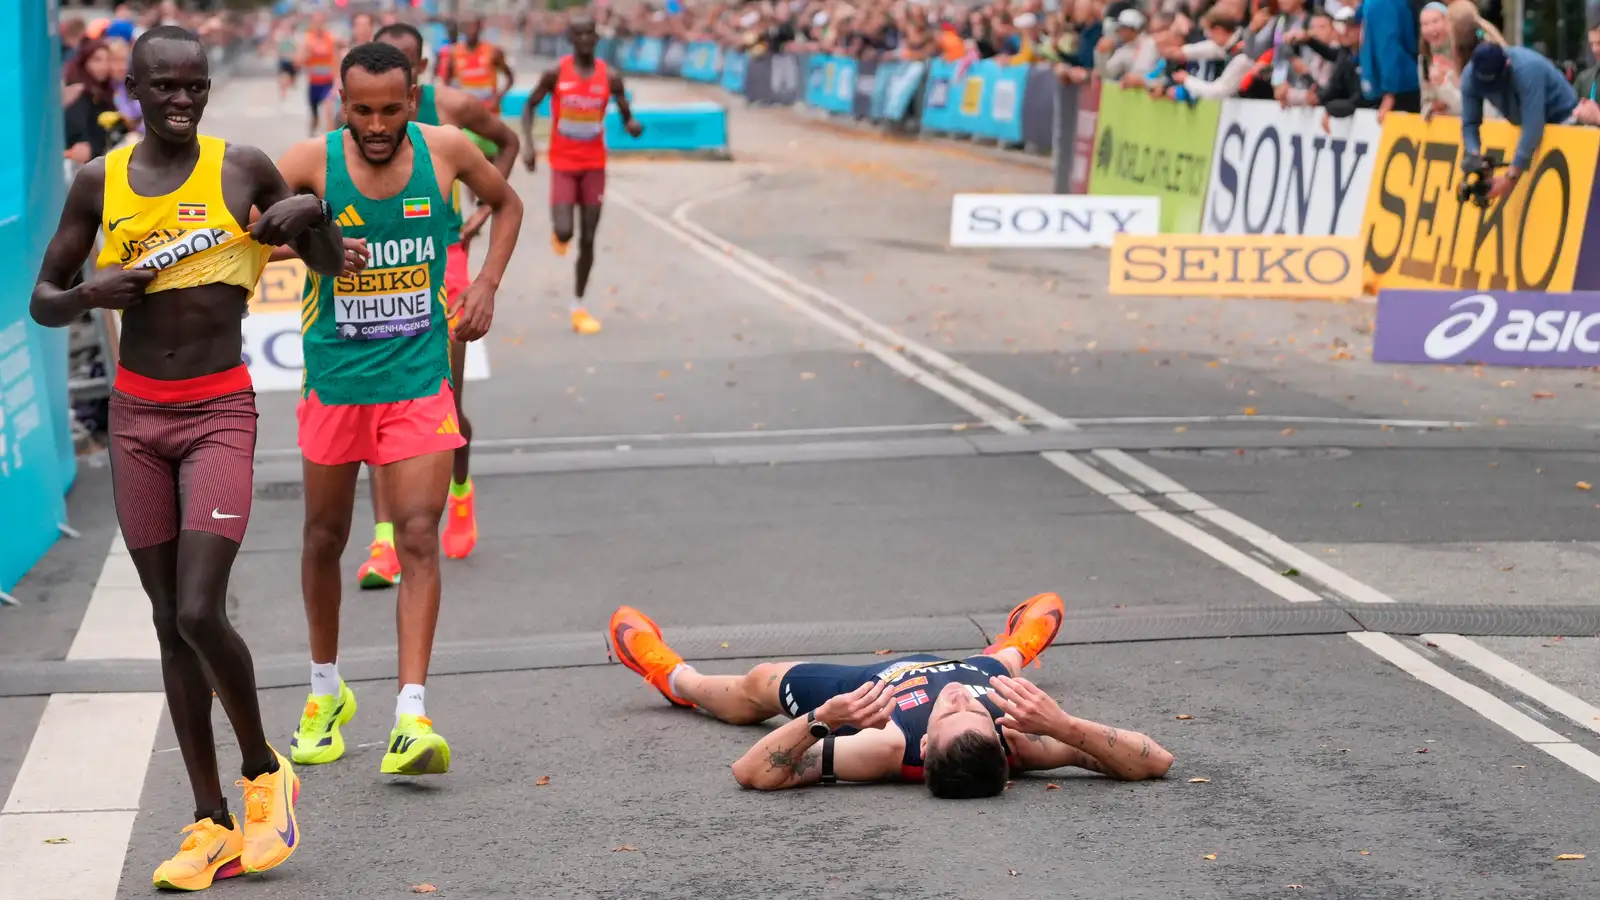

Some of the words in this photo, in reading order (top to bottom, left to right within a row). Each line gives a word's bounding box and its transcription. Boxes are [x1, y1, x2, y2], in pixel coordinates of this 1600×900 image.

[1208, 122, 1369, 235] SONY
[967, 206, 1142, 235] SONY
[1364, 135, 1571, 292] SEIKO
[336, 268, 427, 293] SEIKO
[1123, 246, 1351, 285] SEIKO
[340, 293, 426, 319] YIHUNE
[1493, 309, 1600, 353] asic
